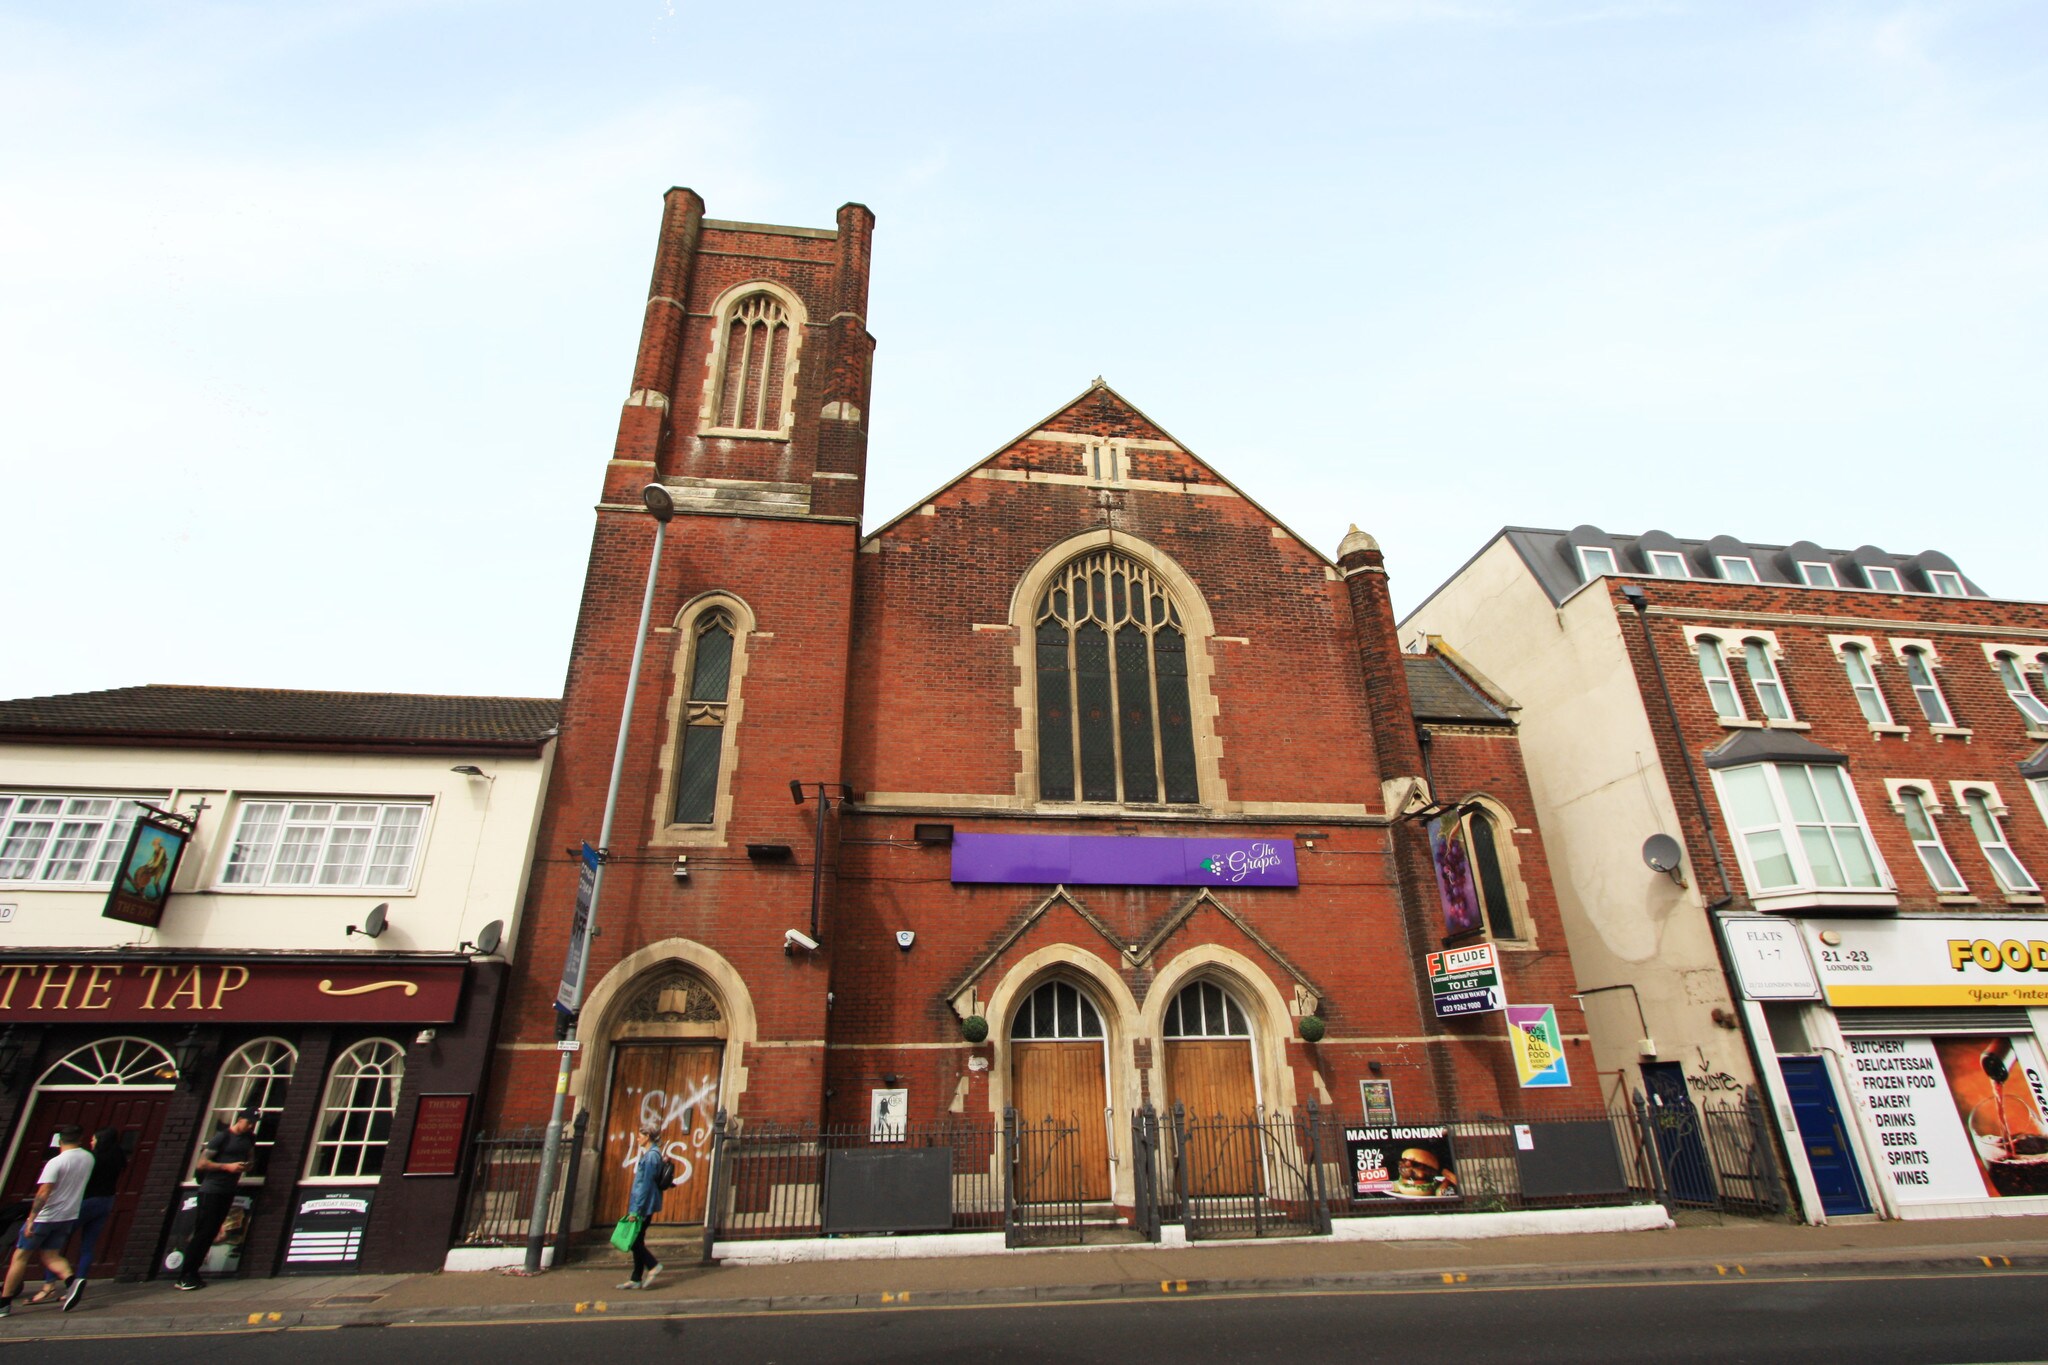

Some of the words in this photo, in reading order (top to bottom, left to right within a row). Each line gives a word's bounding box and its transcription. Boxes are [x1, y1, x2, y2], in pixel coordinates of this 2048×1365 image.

[1248, 843, 1277, 859] The
[1226, 850, 1282, 882] Grapes
[1746, 931, 1783, 941] FLATS
[1450, 949, 1486, 964] FLUDE
[0, 964, 123, 1009] THE
[139, 964, 250, 1009] TAP
[1448, 982, 1461, 990] TO
[1462, 979, 1479, 988] LET
[1968, 988, 2009, 1002] Your
[1525, 1026, 1545, 1035] 50%
[1529, 1034, 1546, 1042] OFF
[1850, 1040, 1905, 1053] BUTCHERY
[1856, 1058, 1934, 1071] DELICATESSAN
[1862, 1076, 1905, 1089] FROZEN
[1906, 1075, 1936, 1088] FOOD
[1868, 1095, 1911, 1108] BAKERY
[1875, 1113, 1916, 1127] DRINKS
[1346, 1128, 1389, 1141] MANIC
[1391, 1127, 1444, 1139] MONDAY
[1881, 1132, 1918, 1146] BEERS
[1356, 1148, 1384, 1160] 50%
[1887, 1150, 1929, 1165] SPIRITS
[1357, 1159, 1382, 1170] OFF
[1360, 1170, 1387, 1181] FOOD
[1893, 1170, 1930, 1185] WINES
